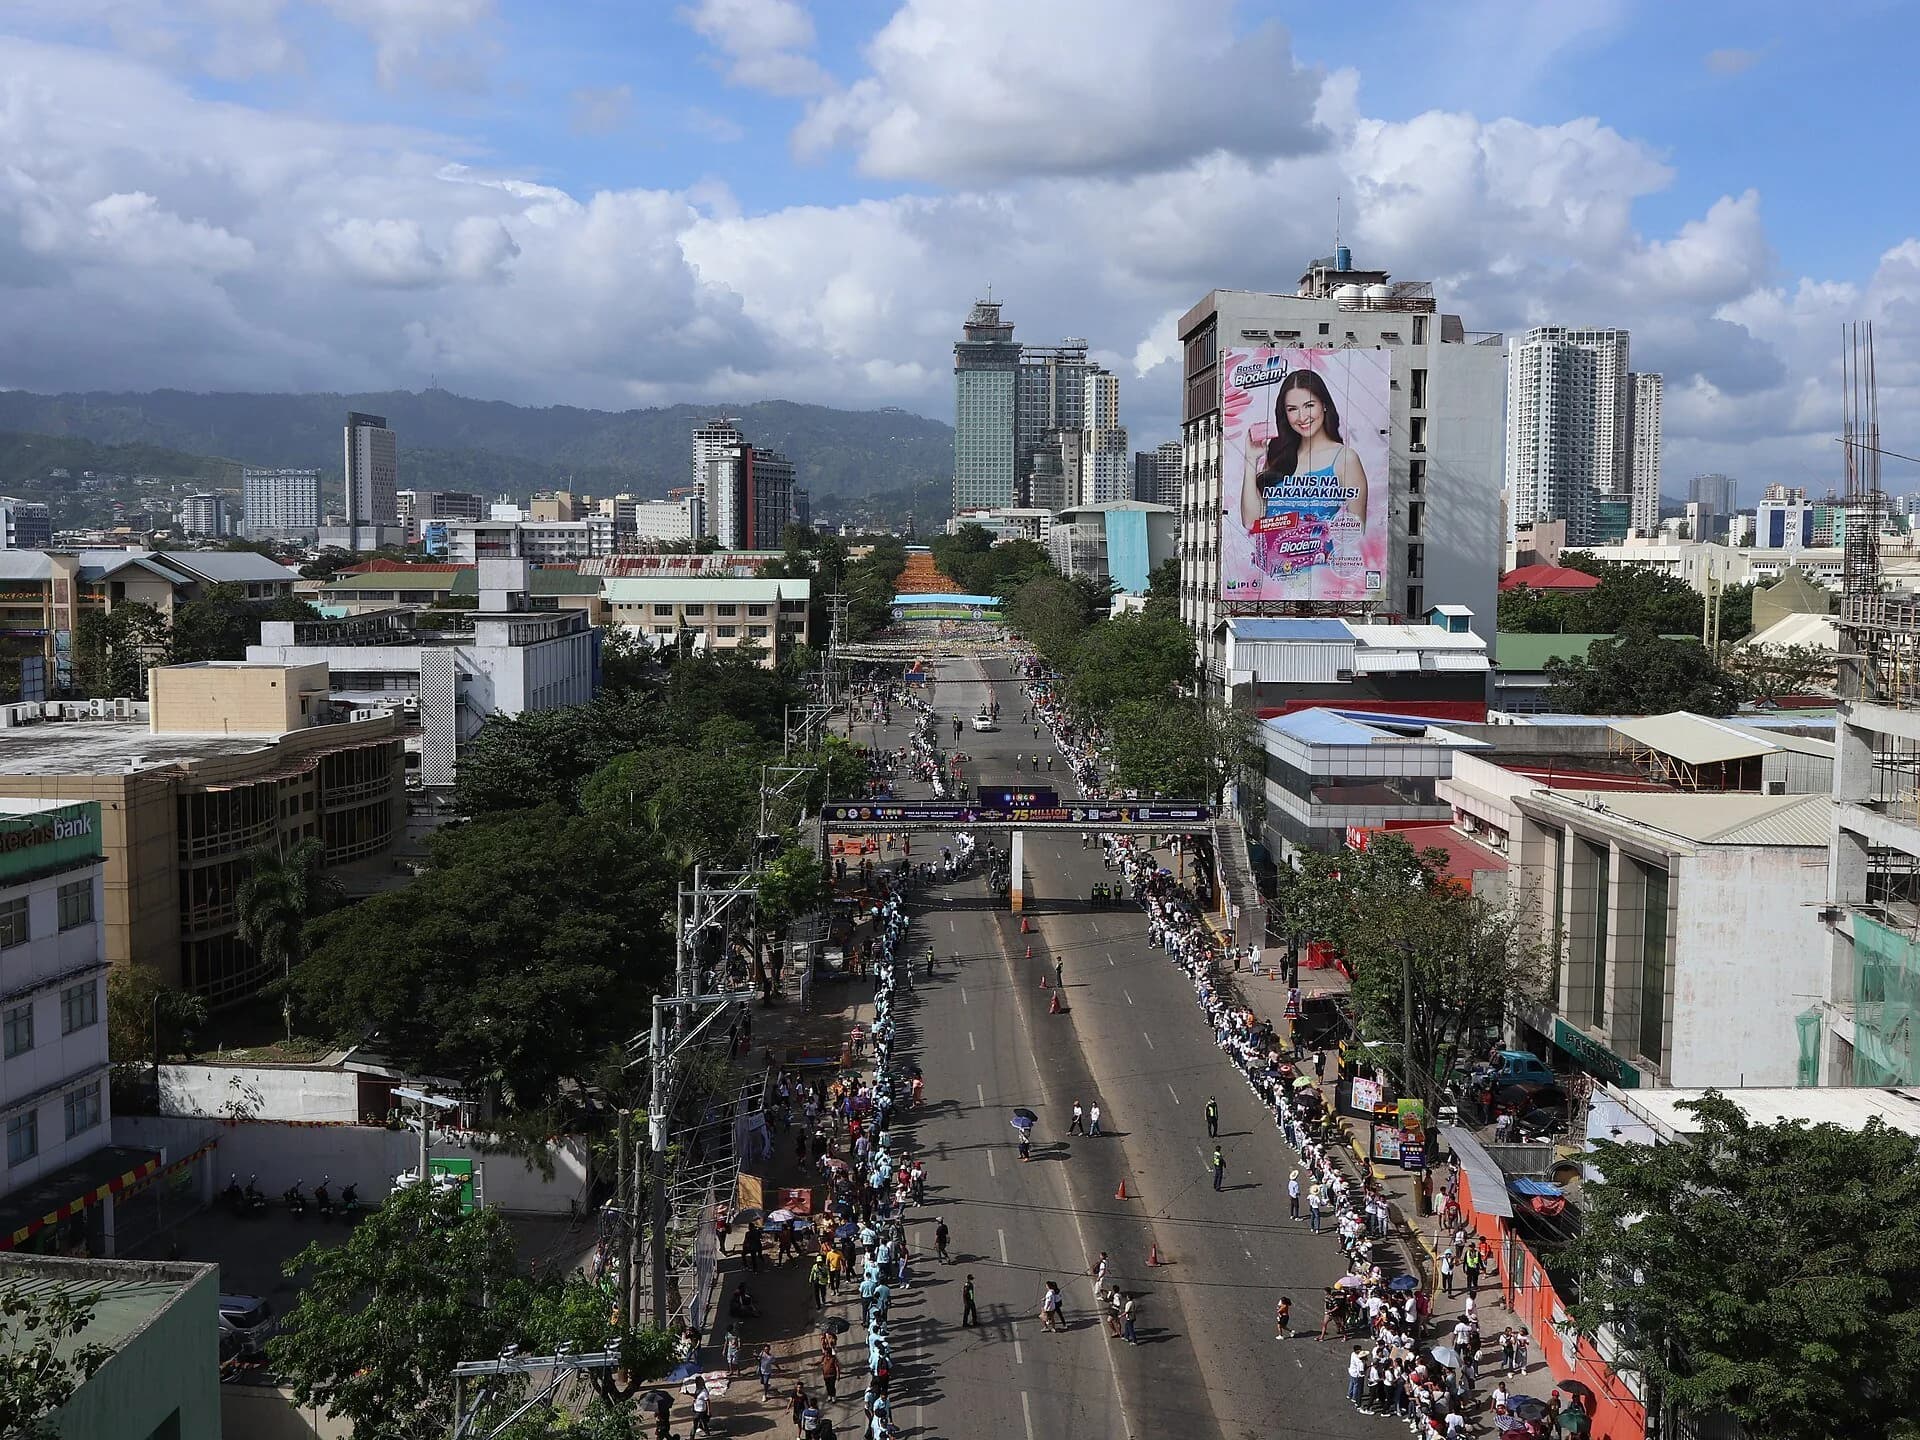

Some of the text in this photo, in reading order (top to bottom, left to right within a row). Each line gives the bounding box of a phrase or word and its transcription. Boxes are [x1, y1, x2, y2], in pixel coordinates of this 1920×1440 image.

[1237, 363, 1262, 374] Basta
[1284, 476, 1339, 487] LINIS NA
[1263, 487, 1359, 498] NAKAKAKINIS!
[1280, 540, 1320, 554] Bioderm
